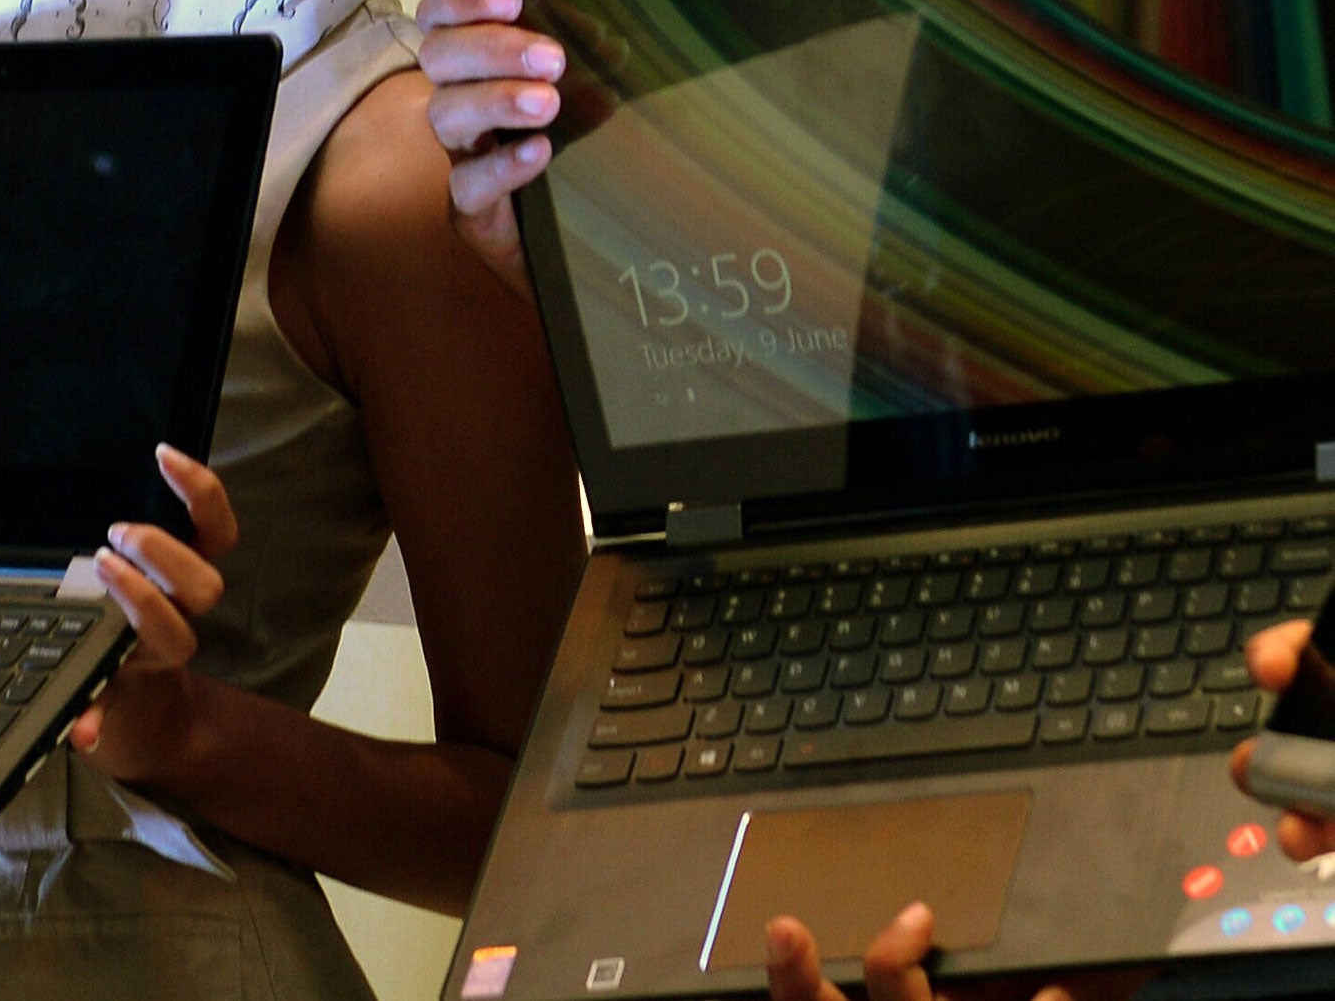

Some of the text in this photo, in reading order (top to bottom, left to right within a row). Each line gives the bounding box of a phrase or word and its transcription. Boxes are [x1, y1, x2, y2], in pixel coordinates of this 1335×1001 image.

[618, 248, 792, 328] 13:59
[760, 330, 777, 360] 9
[787, 327, 850, 355] June
[967, 424, 1063, 451] lenovo
